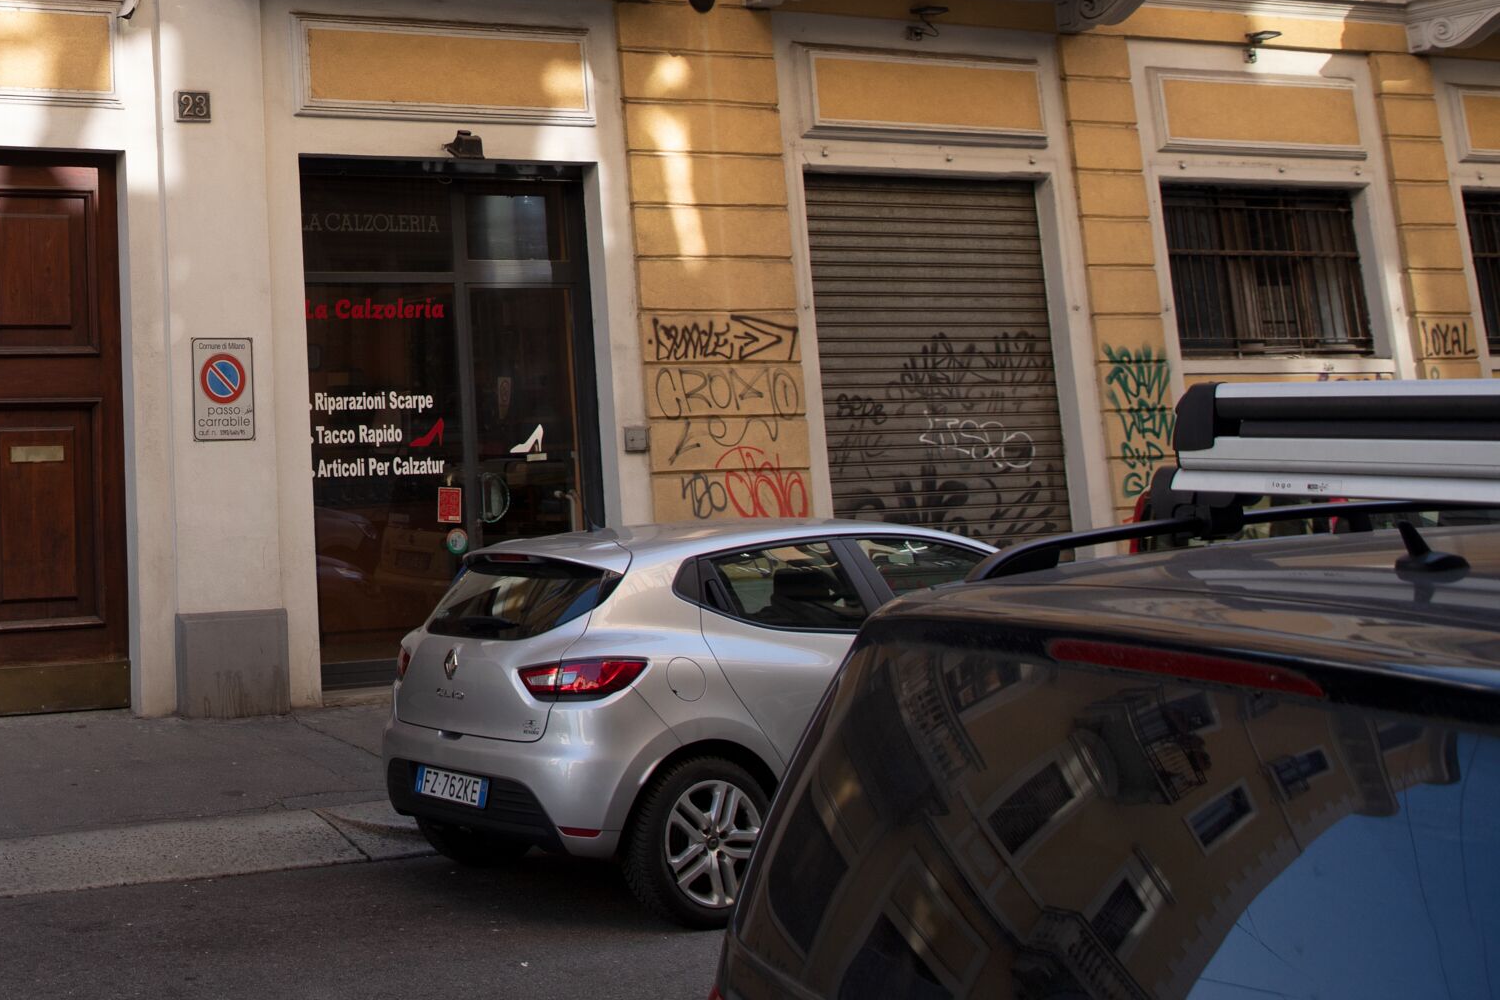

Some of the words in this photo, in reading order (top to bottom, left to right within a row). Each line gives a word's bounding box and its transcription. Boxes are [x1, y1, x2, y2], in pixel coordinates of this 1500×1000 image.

[181, 94, 206, 117] 23
[325, 212, 440, 233] CALZOLERIA
[304, 299, 328, 319] La
[335, 297, 445, 319] Calzoleria
[198, 342, 220, 350] Comune
[222, 342, 227, 350] di
[228, 342, 246, 350] Milano
[1421, 320, 1476, 357] LOYAL
[207, 406, 240, 417] passo
[314, 392, 386, 415] Riparazioni
[389, 390, 434, 413] Scarpe
[198, 416, 251, 427] carrabile
[315, 425, 355, 444] Tacco
[358, 424, 403, 447] Rapido
[317, 458, 365, 478] Articoli
[368, 458, 390, 476] Per
[392, 456, 445, 475] Calzatur
